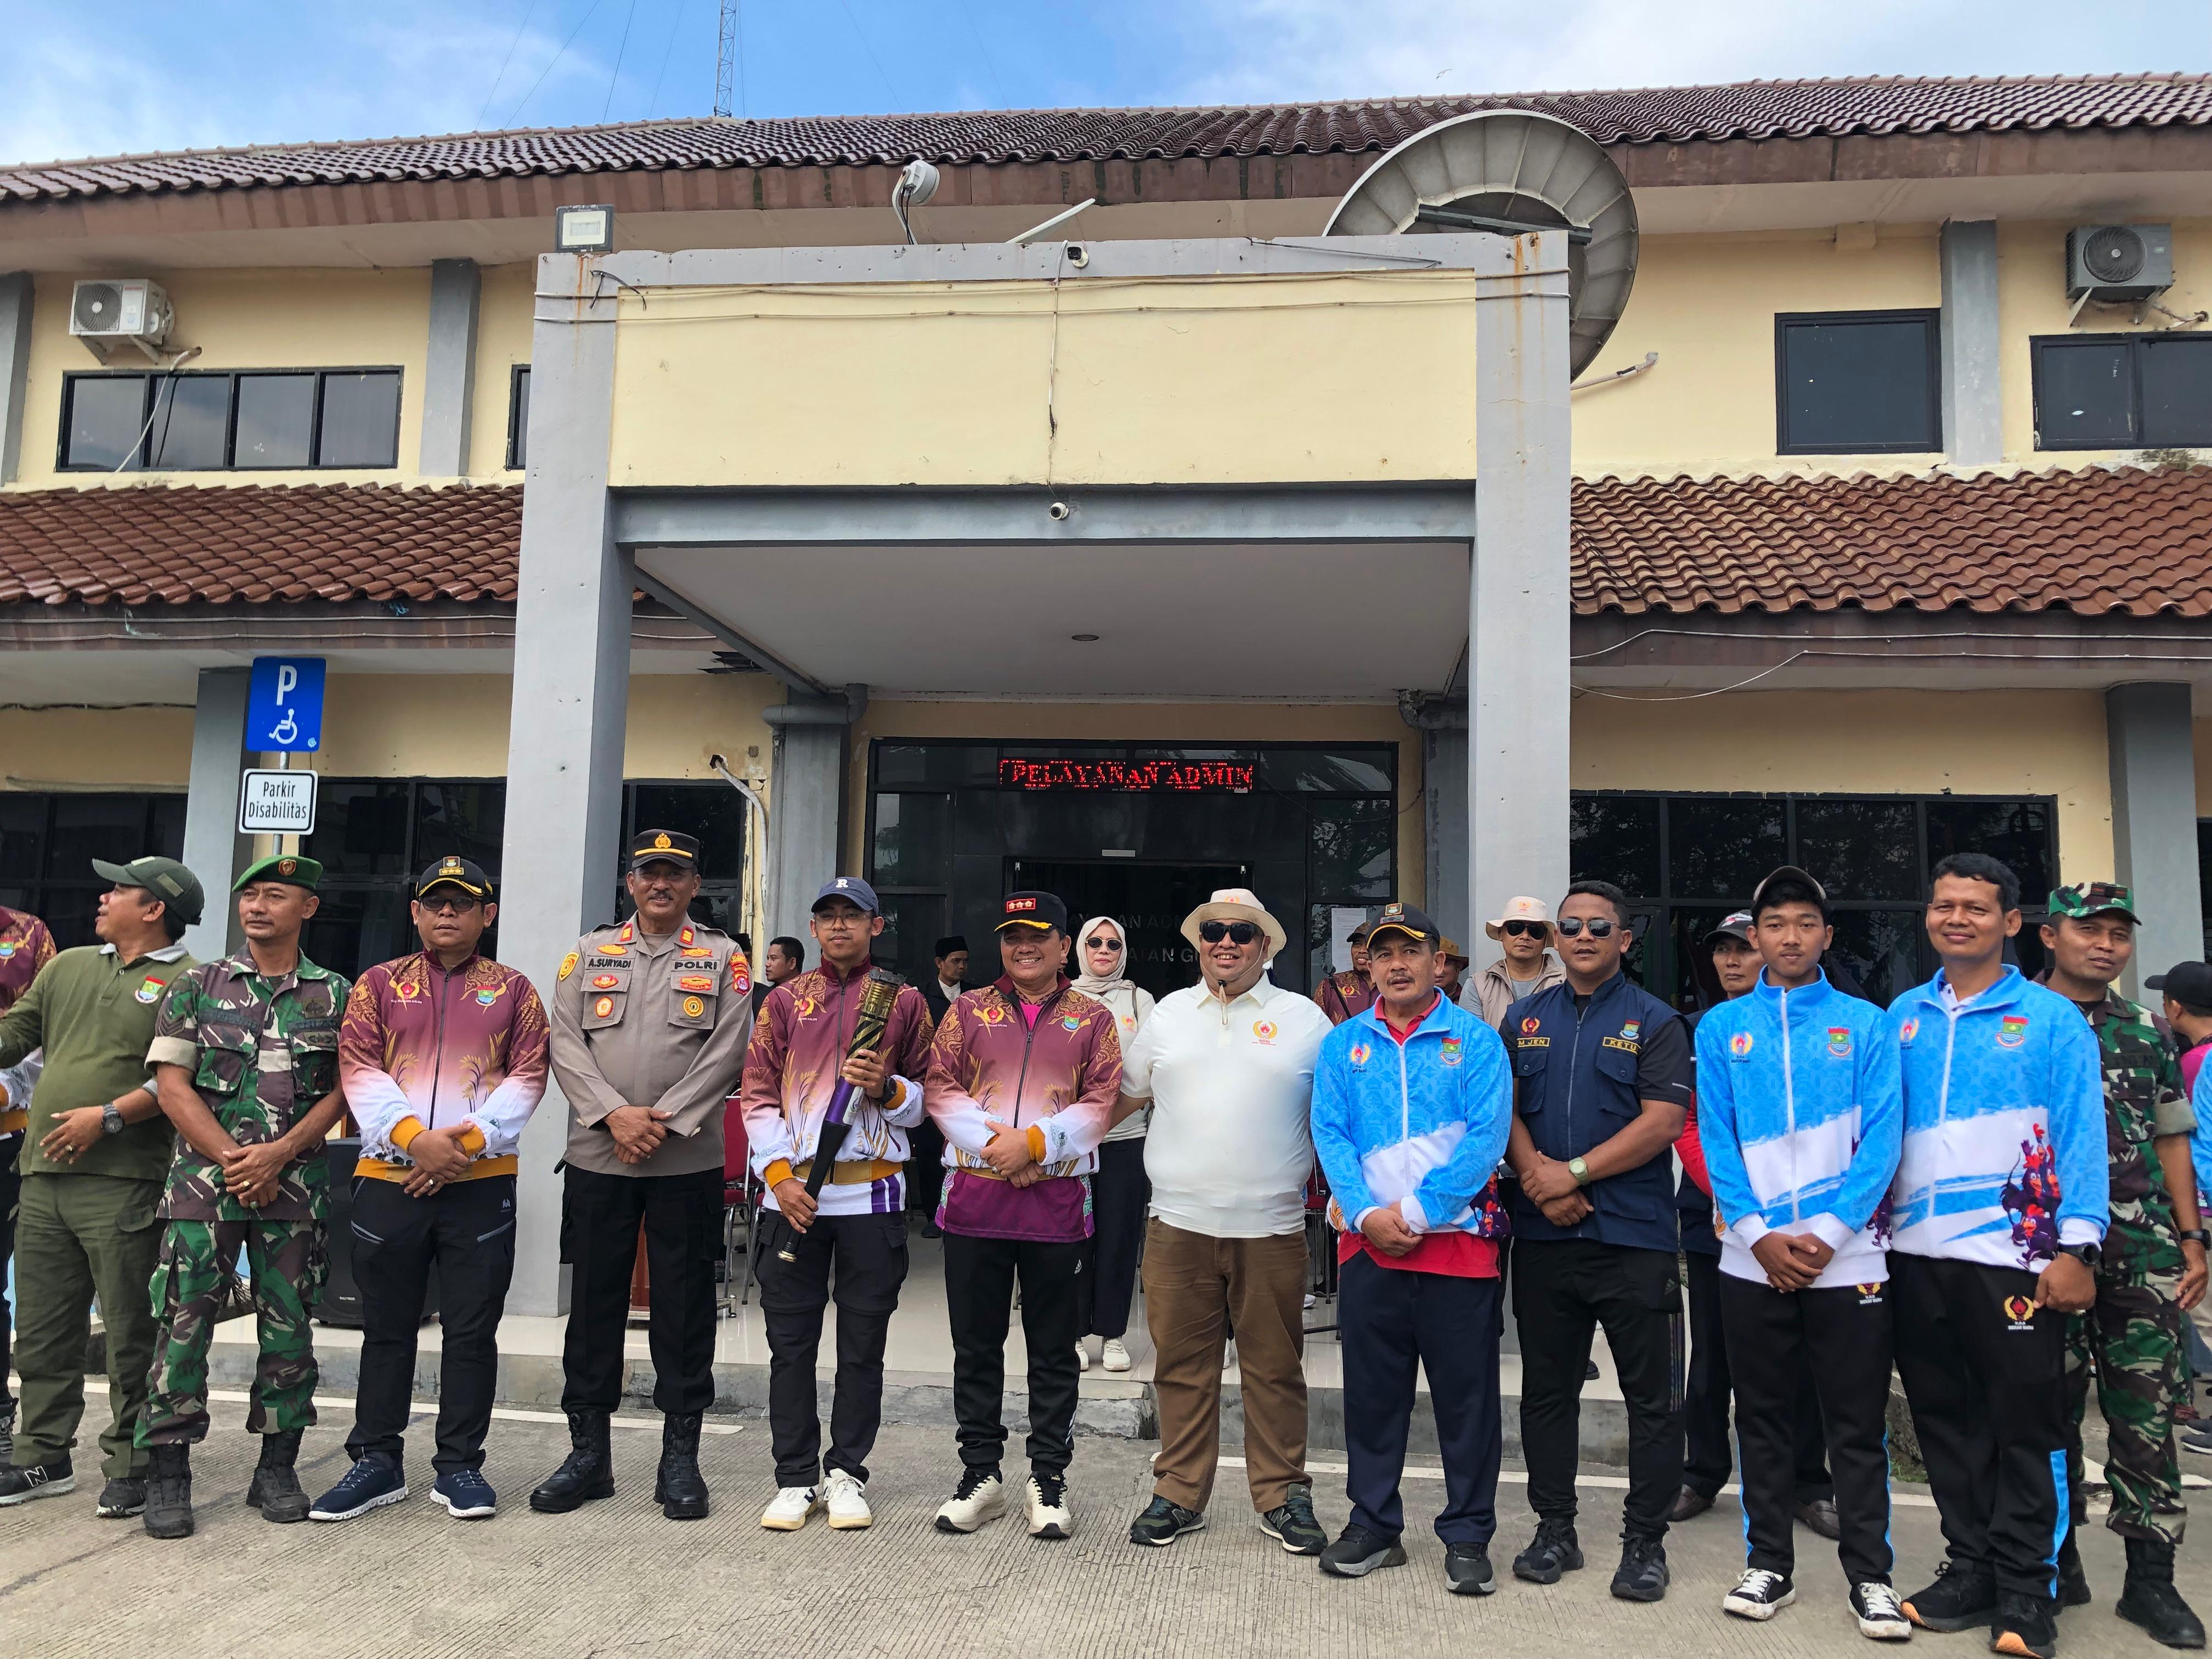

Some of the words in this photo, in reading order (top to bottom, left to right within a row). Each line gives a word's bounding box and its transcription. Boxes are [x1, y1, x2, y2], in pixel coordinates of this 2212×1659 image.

[276, 664, 297, 706] P
[1165, 766, 1251, 785] ADMIN
[263, 781, 296, 798] Parkir
[248, 802, 307, 819] Disabilitas
[836, 879, 849, 888] R
[588, 958, 631, 968] A.SURYADI
[674, 961, 717, 970] POLRI
[1609, 1039, 1637, 1051] KETU
